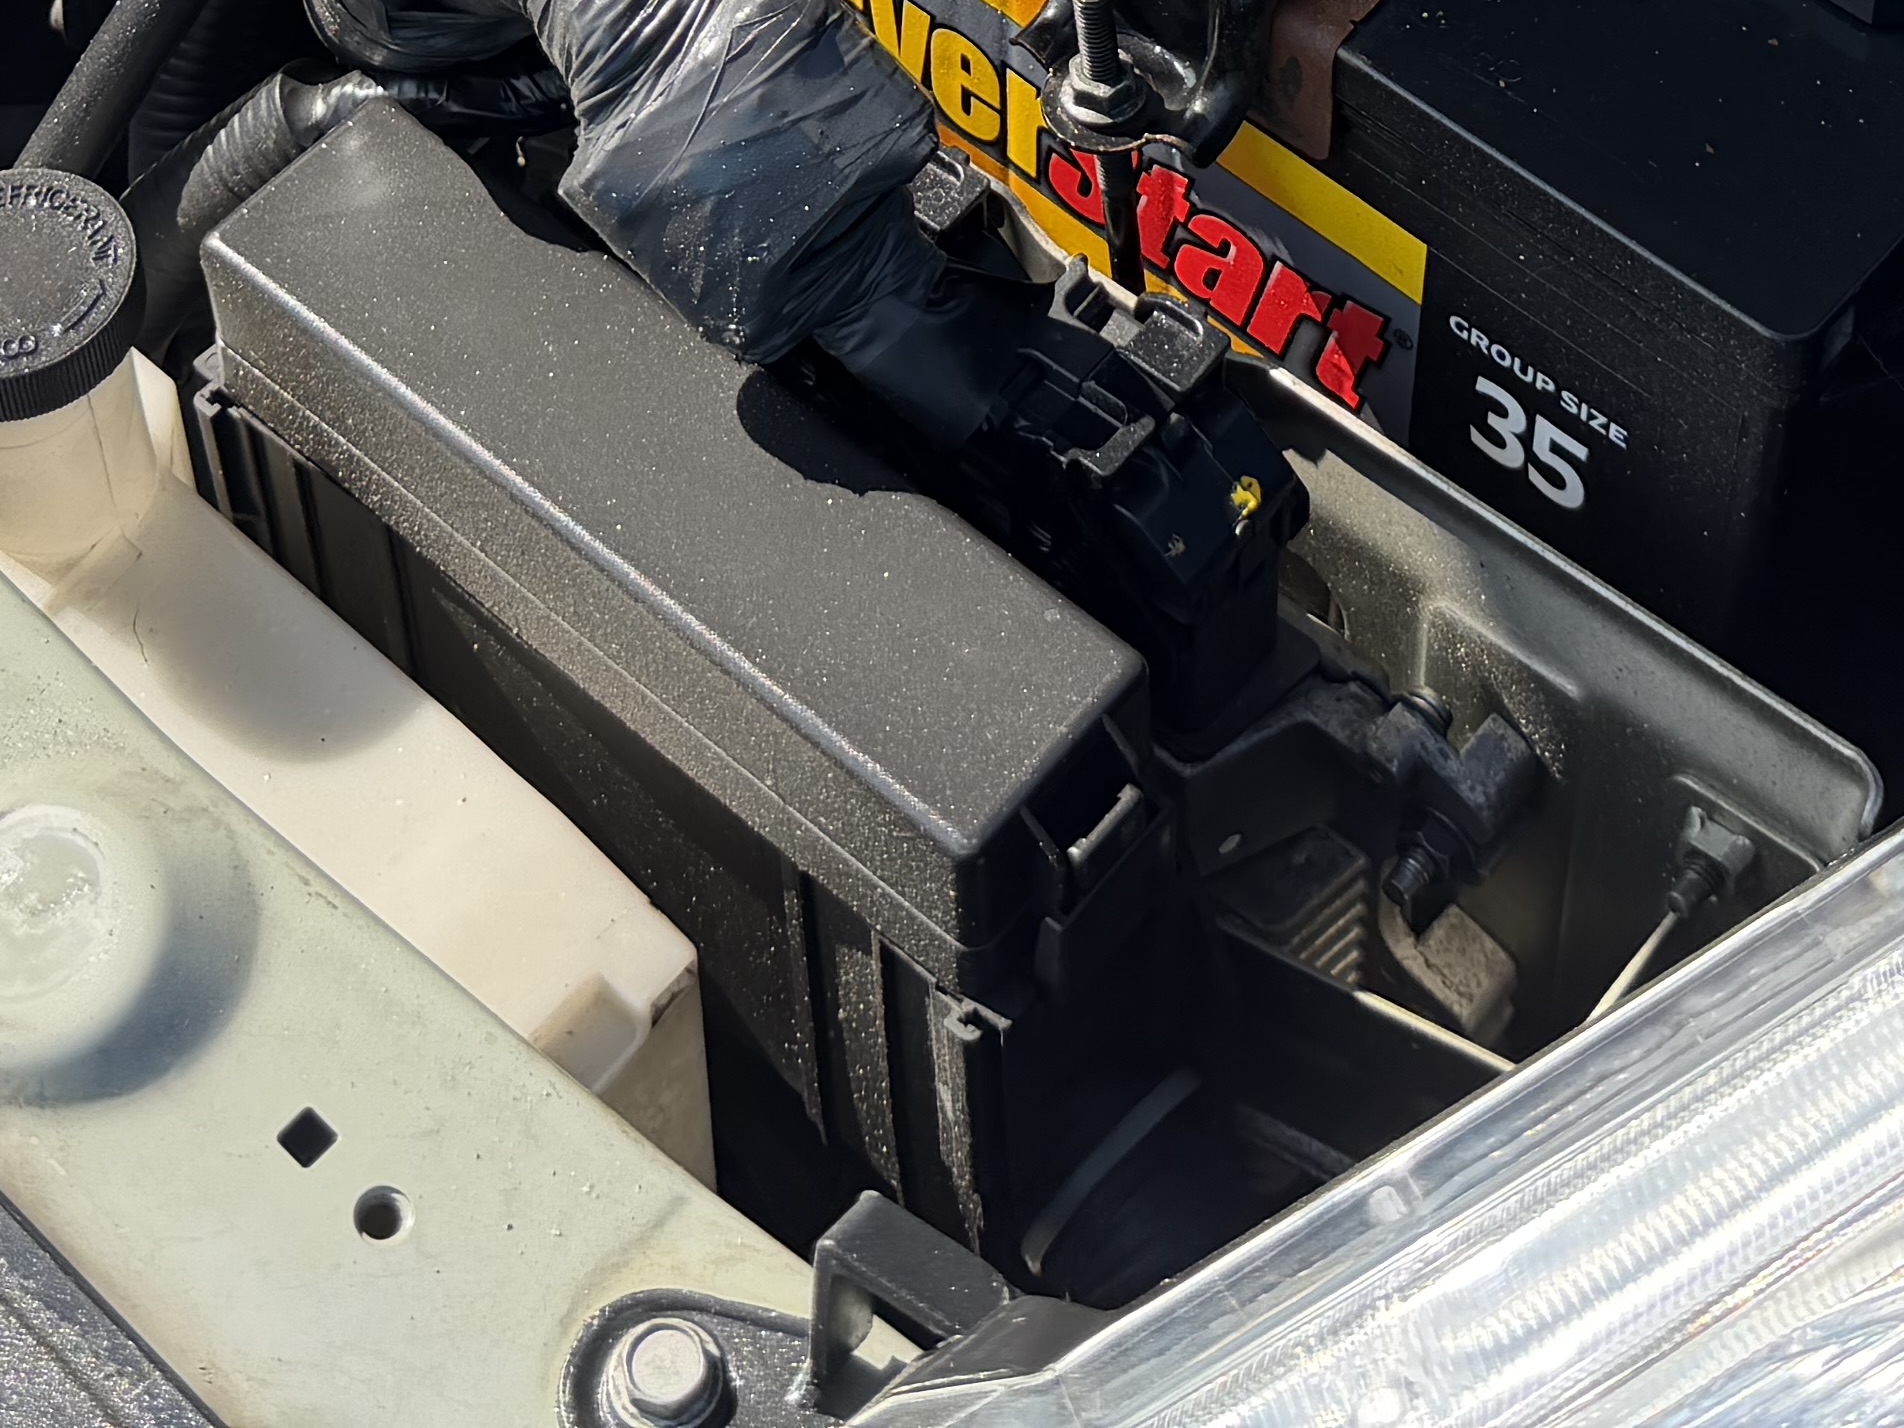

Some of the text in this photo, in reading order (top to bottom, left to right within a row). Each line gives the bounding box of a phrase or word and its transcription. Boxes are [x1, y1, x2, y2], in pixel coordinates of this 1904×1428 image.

[1449, 315, 1630, 451] GROUP SIZE
[1469, 375, 1590, 510] 35
